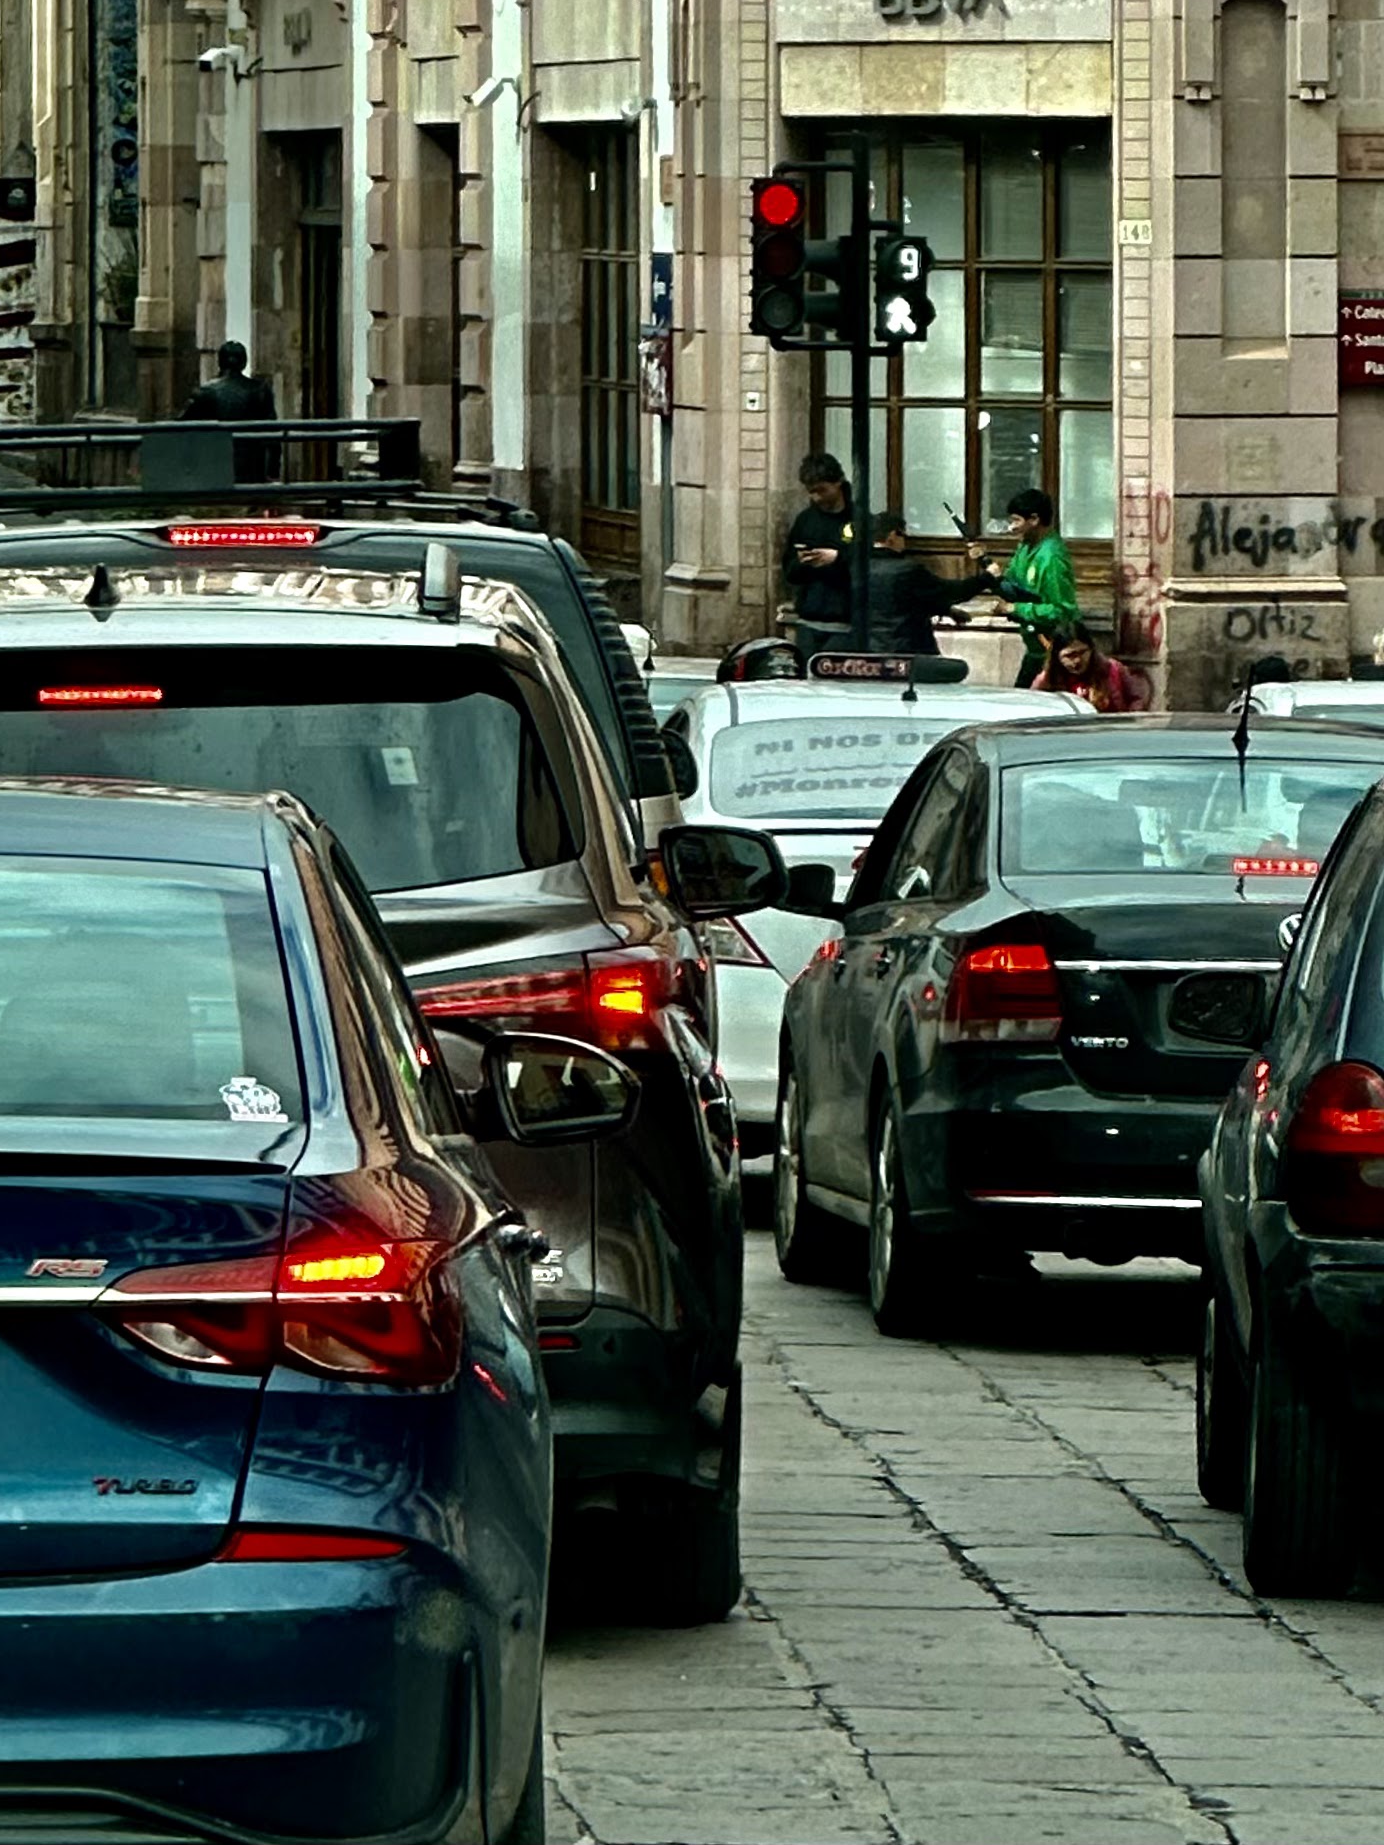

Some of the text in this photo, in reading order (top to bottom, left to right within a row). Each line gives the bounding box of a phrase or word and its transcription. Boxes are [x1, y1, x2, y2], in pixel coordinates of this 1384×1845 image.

[900, 245, 922, 281] 9
[1354, 304, 1384, 320] Cate
[807, 733, 883, 751] NOS
[735, 777, 907, 799] #Monro
[1070, 1035, 1129, 1049] VENTO
[24, 1258, 109, 1278] RS
[92, 1477, 201, 1497] TURBO
